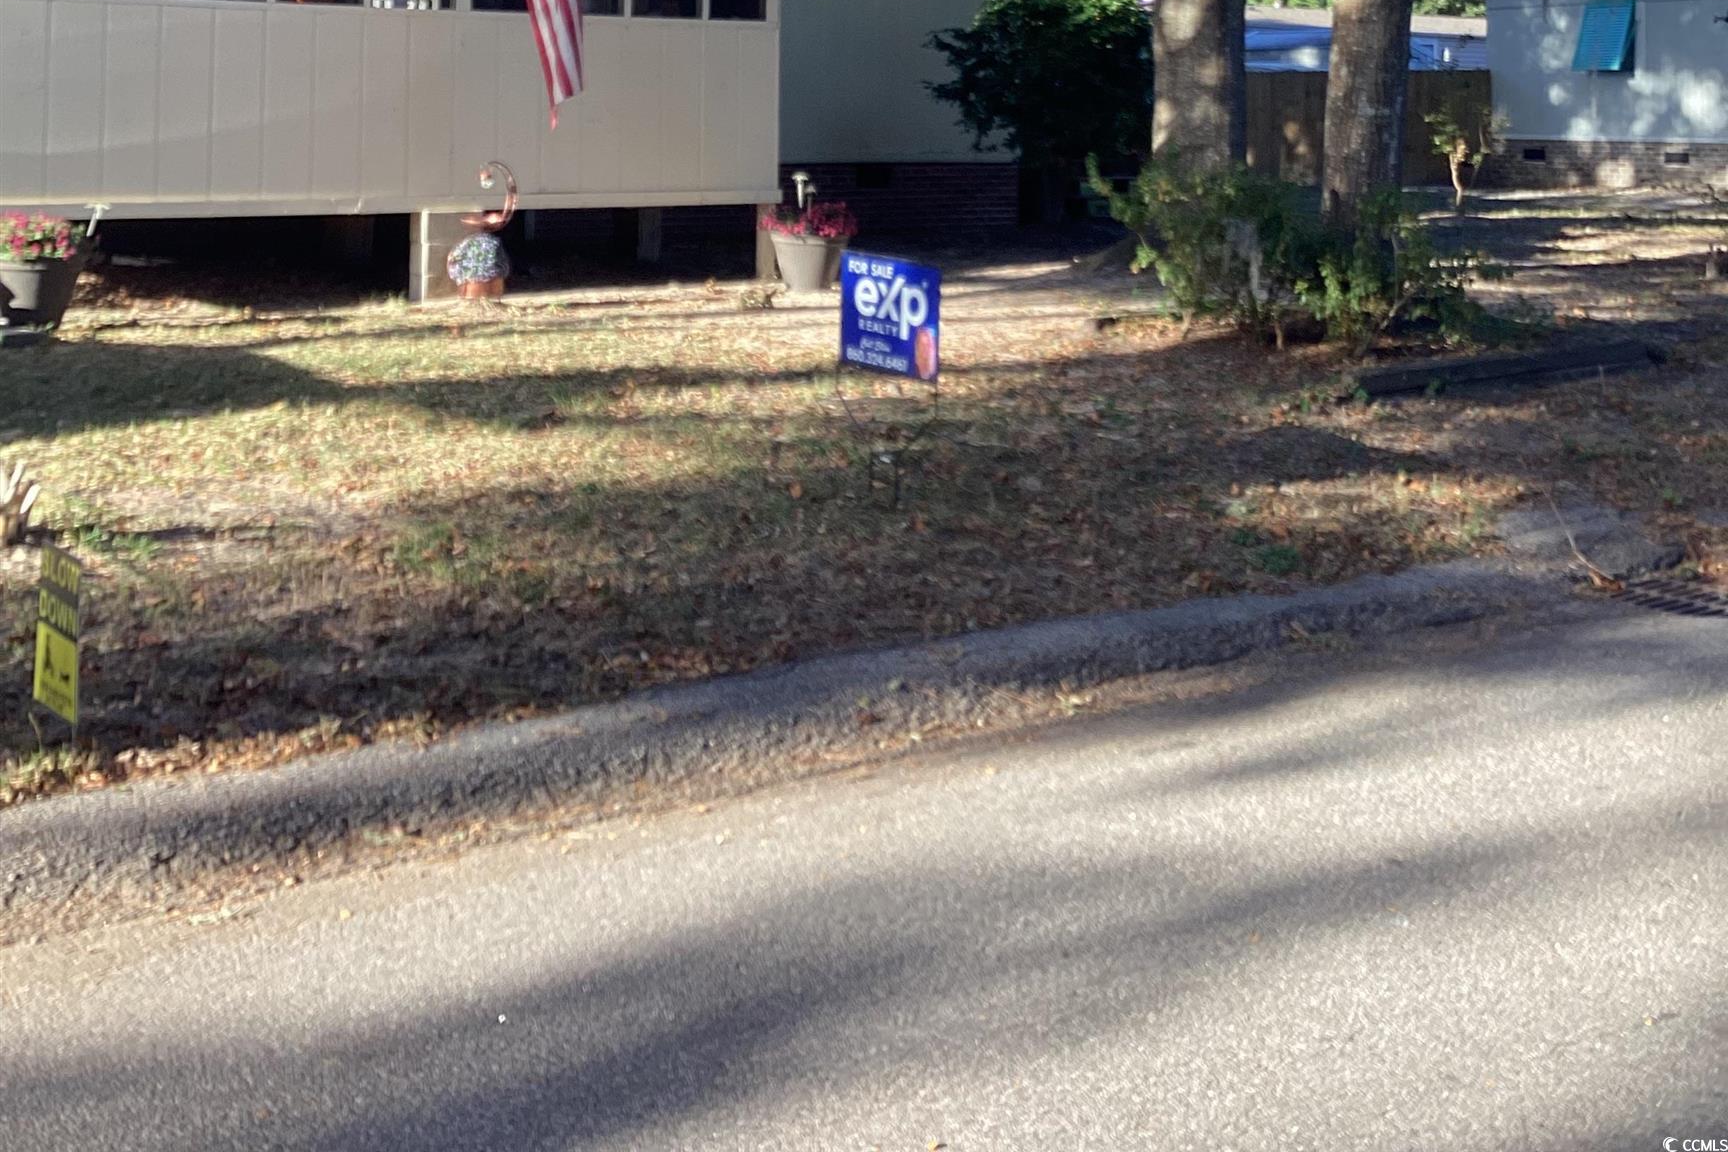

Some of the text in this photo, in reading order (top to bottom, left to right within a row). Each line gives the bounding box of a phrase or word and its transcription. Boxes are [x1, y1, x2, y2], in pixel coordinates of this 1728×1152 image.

[848, 259, 894, 280] FOR SALE
[858, 319, 899, 336] REALTY
[41, 549, 80, 595] SLOW
[39, 588, 77, 638] DOWN
